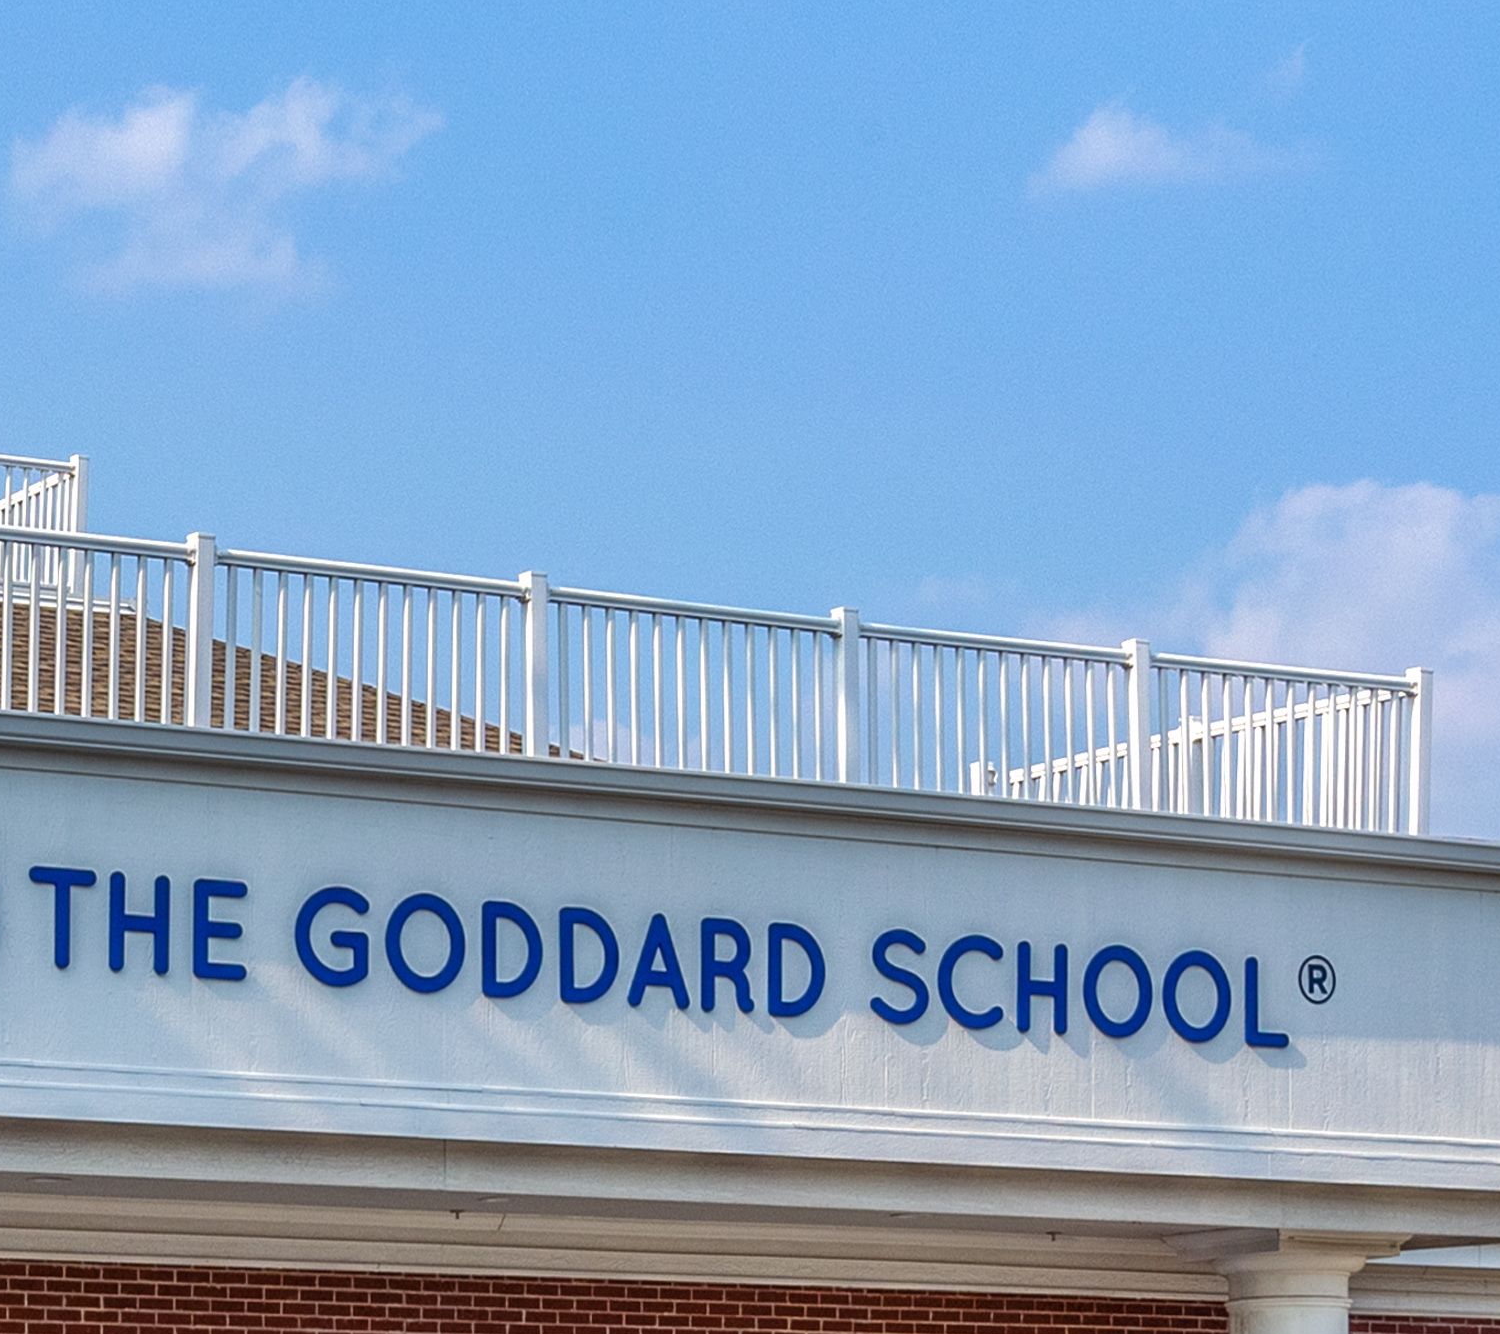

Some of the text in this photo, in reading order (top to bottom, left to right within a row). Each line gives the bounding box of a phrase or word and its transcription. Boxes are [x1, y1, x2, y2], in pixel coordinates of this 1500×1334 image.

[28, 865, 249, 981] THE
[293, 884, 827, 1019] GODDARD
[869, 928, 1290, 1049] SCHOOL
